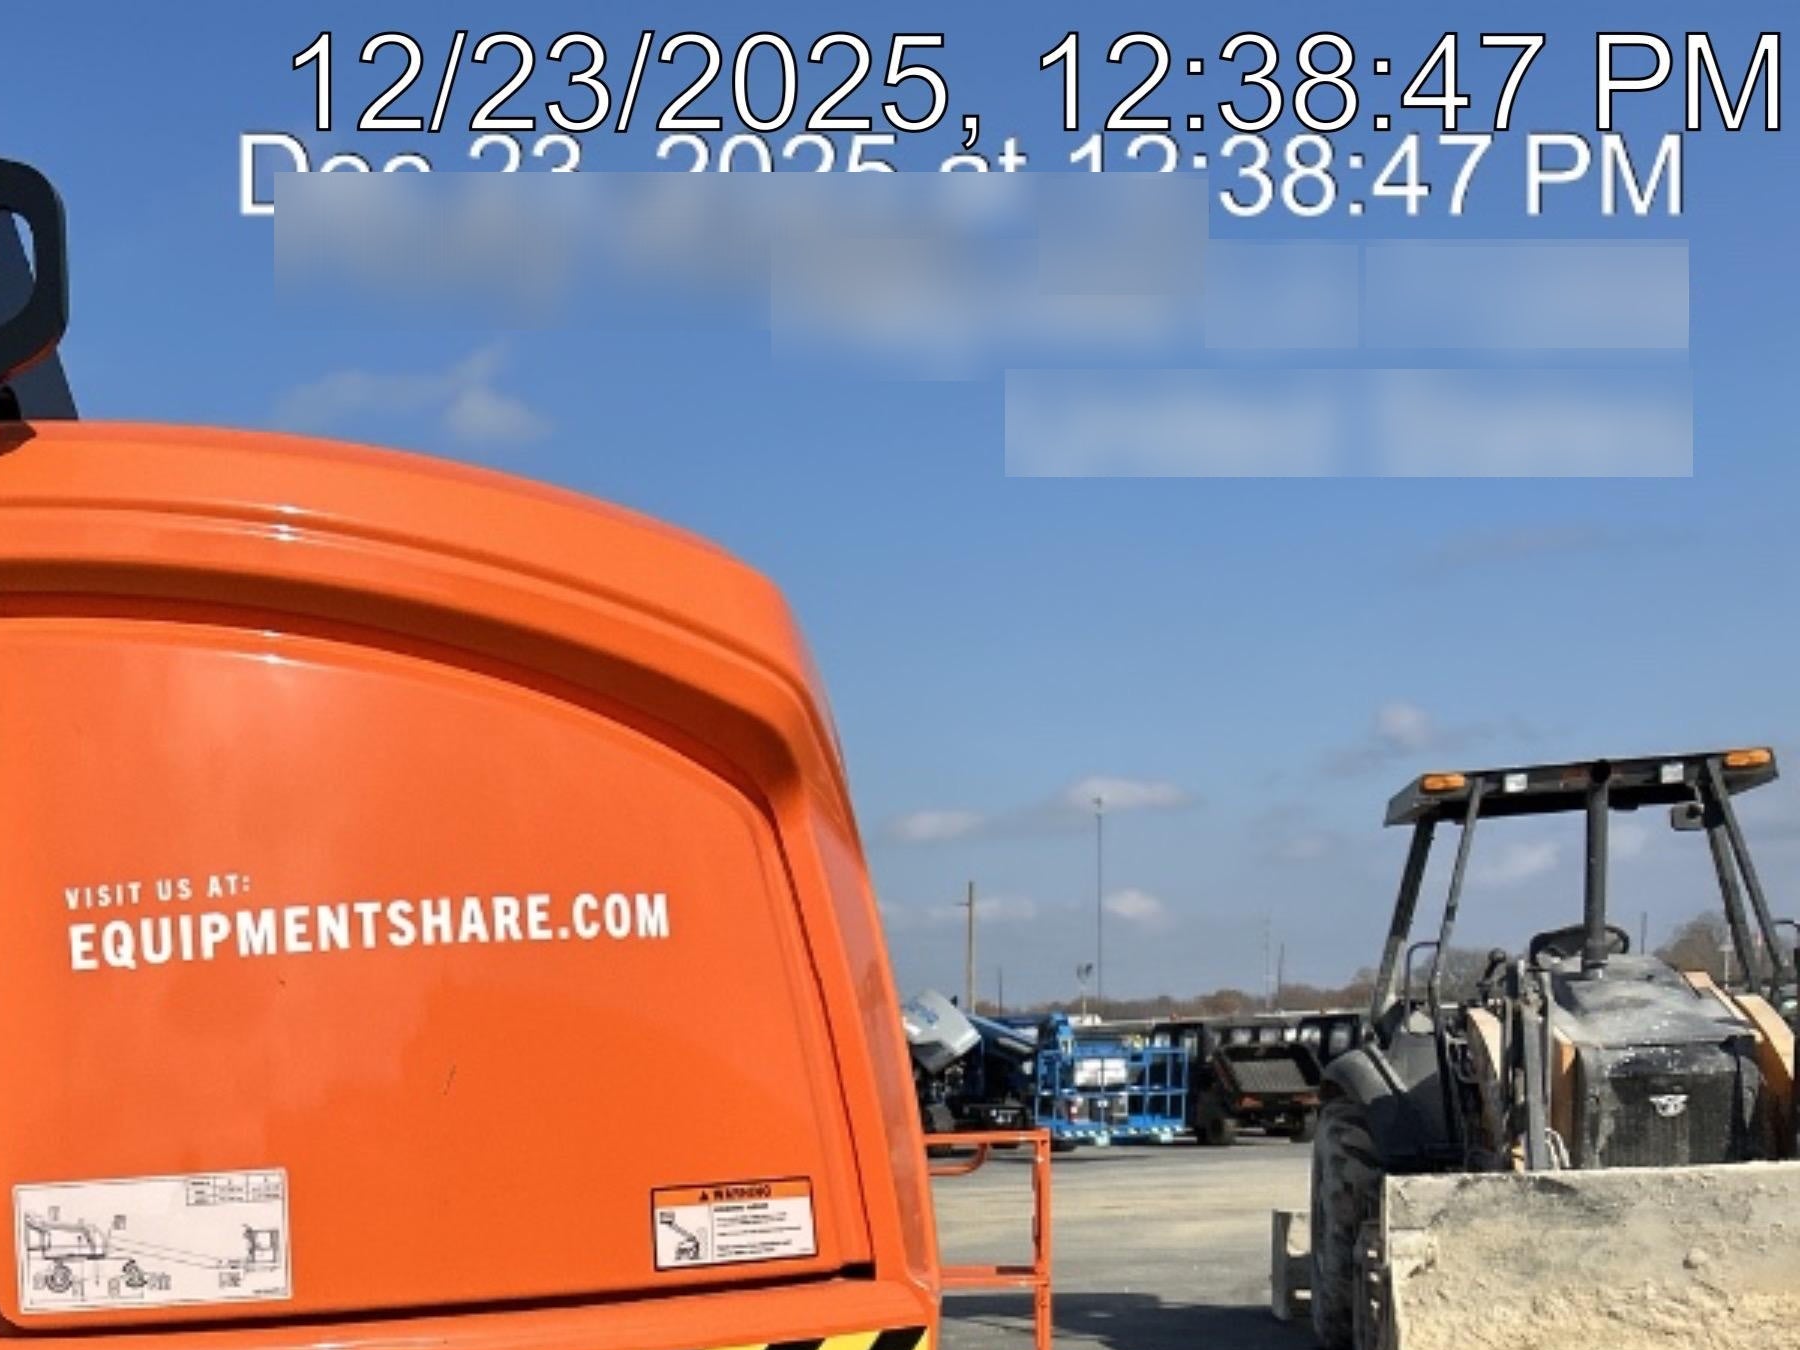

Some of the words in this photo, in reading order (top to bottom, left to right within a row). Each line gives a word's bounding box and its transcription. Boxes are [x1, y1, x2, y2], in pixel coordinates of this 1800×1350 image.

[65, 882, 141, 910] VISIT
[156, 878, 192, 901] US
[206, 873, 250, 898] AT:
[68, 893, 670, 971] EQUIPMENTSHARE.COM
